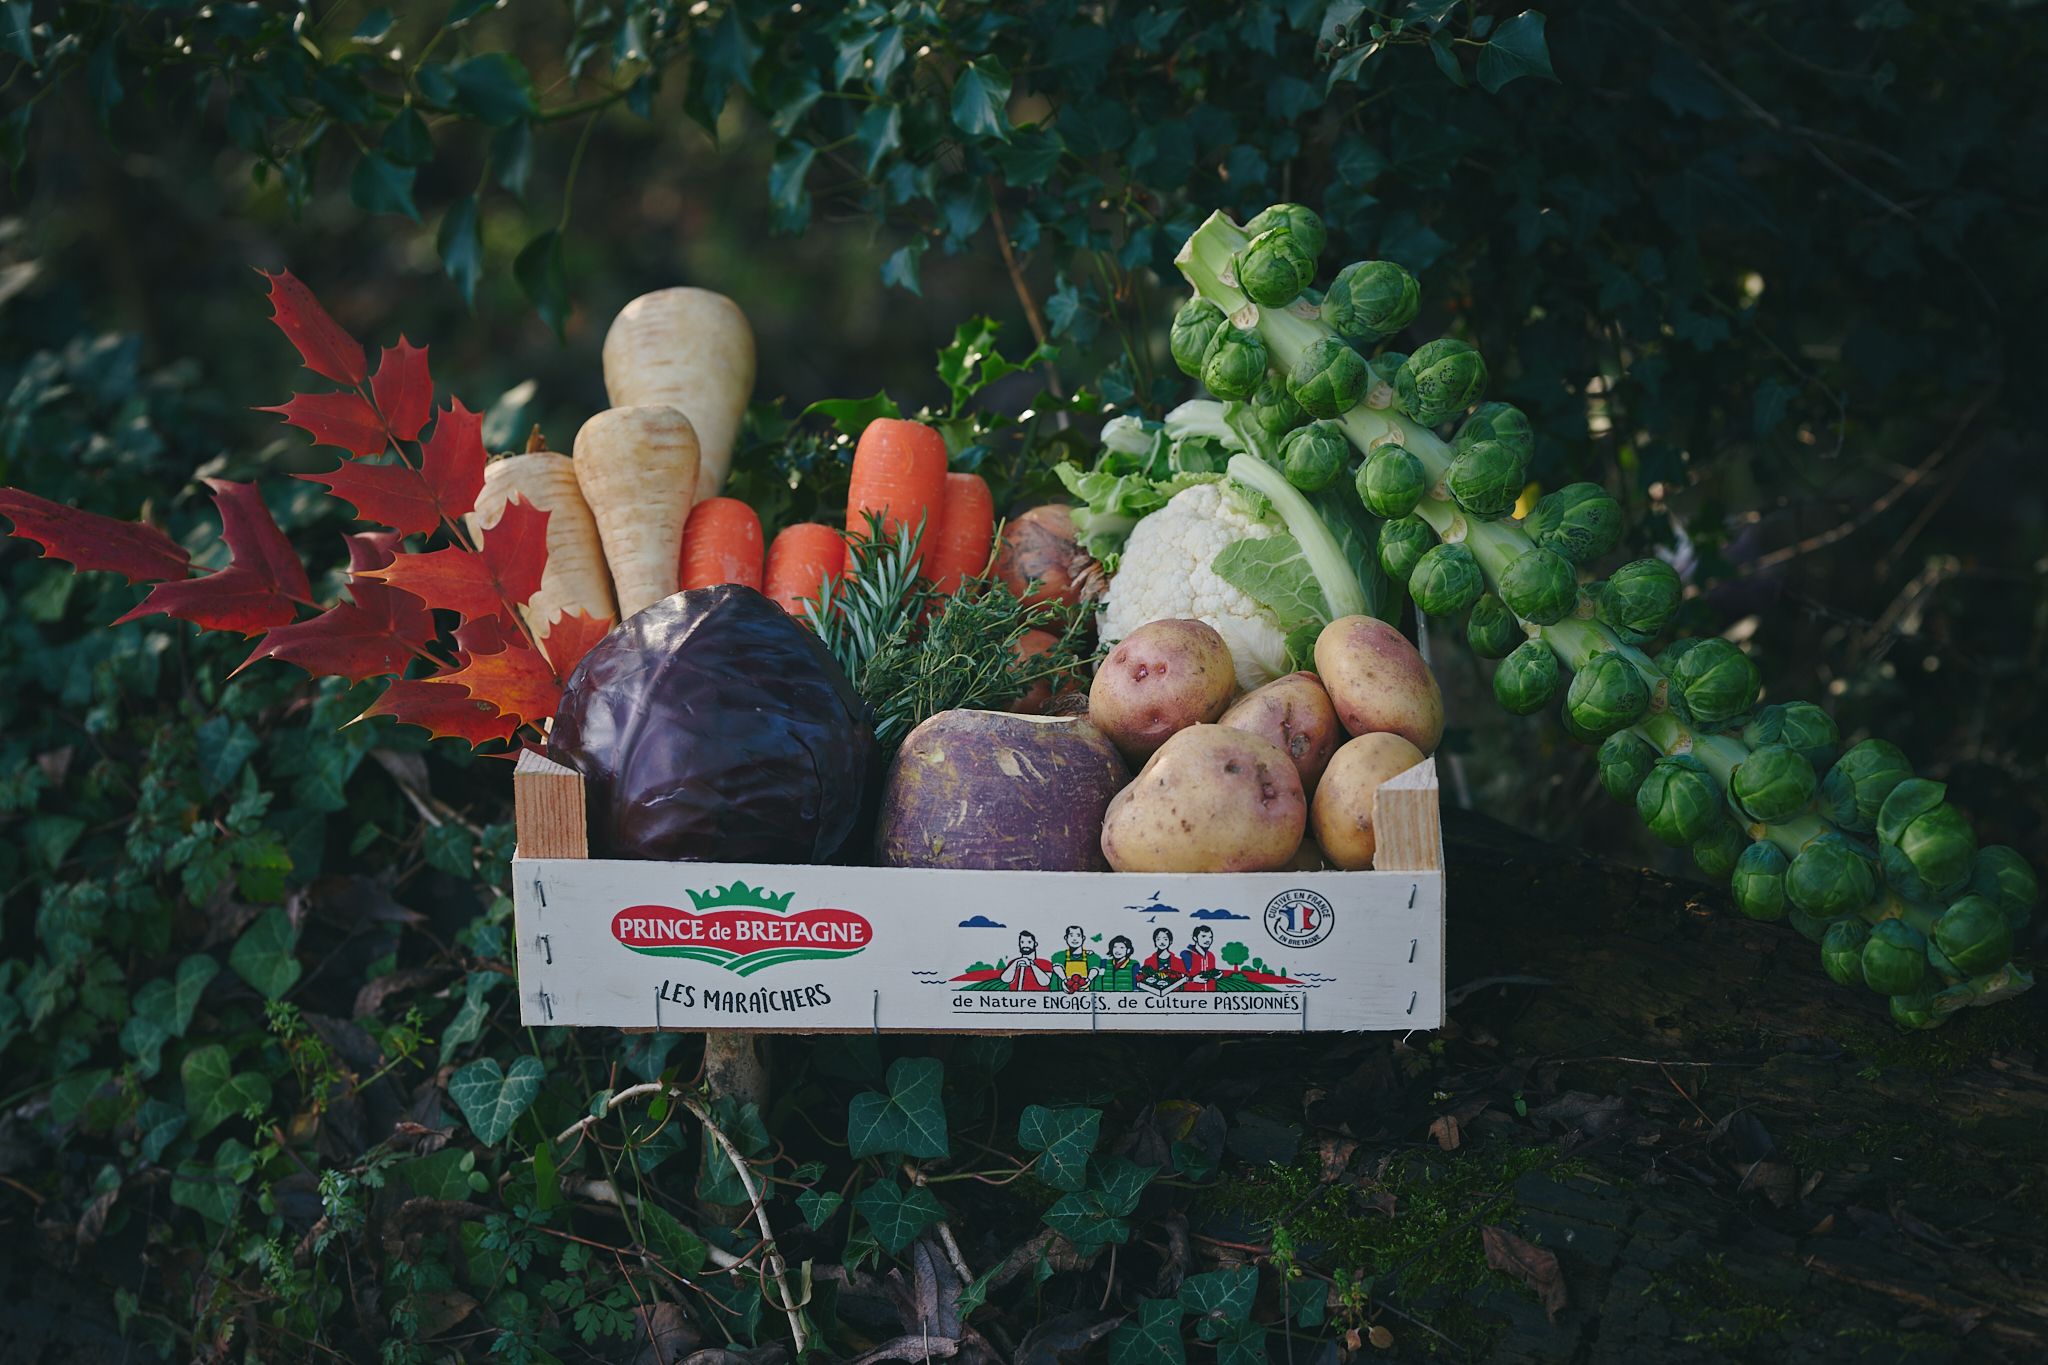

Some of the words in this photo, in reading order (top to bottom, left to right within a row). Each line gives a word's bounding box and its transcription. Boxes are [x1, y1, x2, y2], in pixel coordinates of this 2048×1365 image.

[1306, 894, 1331, 918] FRANCE
[619, 918, 704, 939] PRINCE
[709, 923, 731, 941] de
[736, 920, 864, 942] BRETAGNE
[1279, 934, 1287, 943] EN
[1288, 934, 1321, 945] BRETAGNE
[660, 980, 695, 1007] LES
[703, 984, 831, 1013] MARAÎCHERS
[952, 995, 973, 1008] de
[980, 995, 1037, 1008] Nature
[1118, 996, 1138, 1009] de
[1145, 996, 1208, 1009] Culture
[1214, 993, 1299, 1011] PASSIONNÉS
